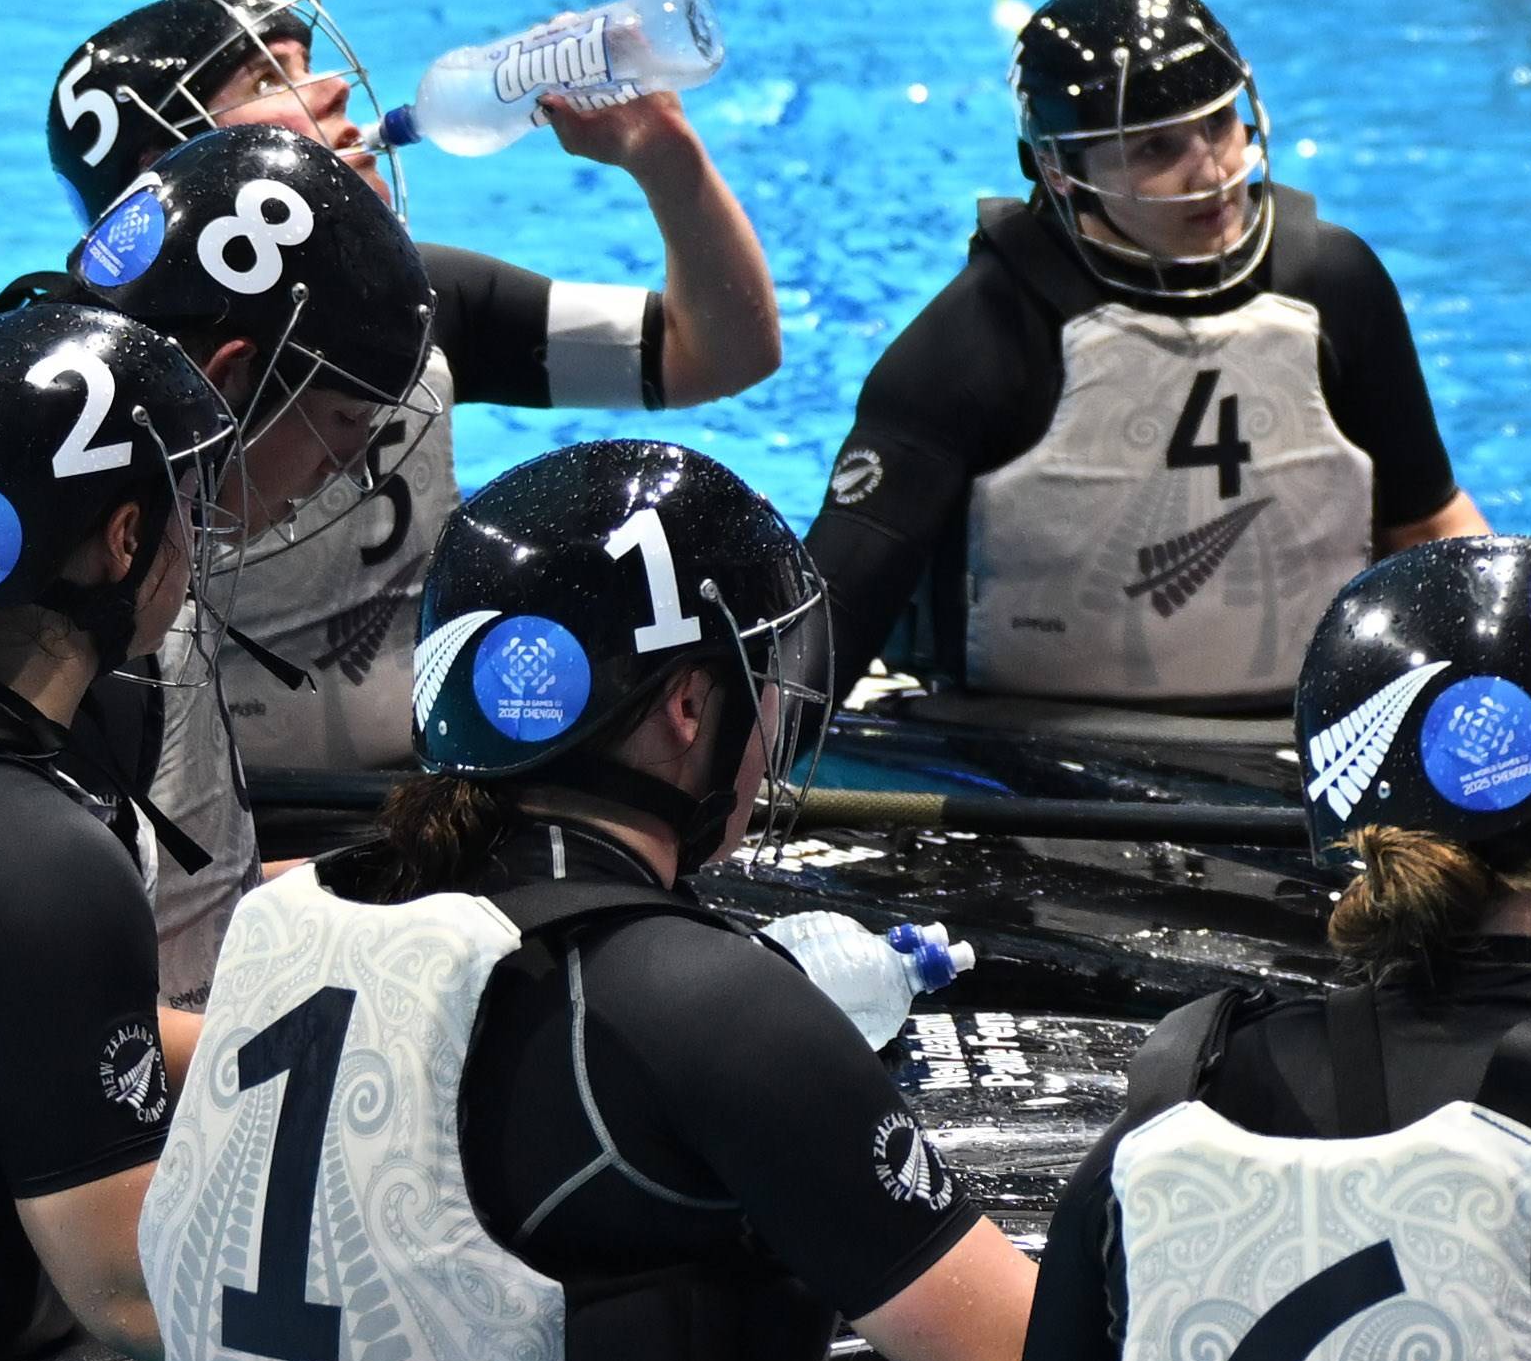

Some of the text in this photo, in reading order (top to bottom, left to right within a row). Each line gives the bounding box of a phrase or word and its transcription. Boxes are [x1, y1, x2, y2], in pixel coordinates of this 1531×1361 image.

[58, 55, 120, 166] 5
[197, 178, 314, 294] 8
[25, 348, 133, 478] 2
[1166, 369, 1252, 499] 4
[603, 509, 700, 655] 1
[497, 708, 521, 719] 2025
